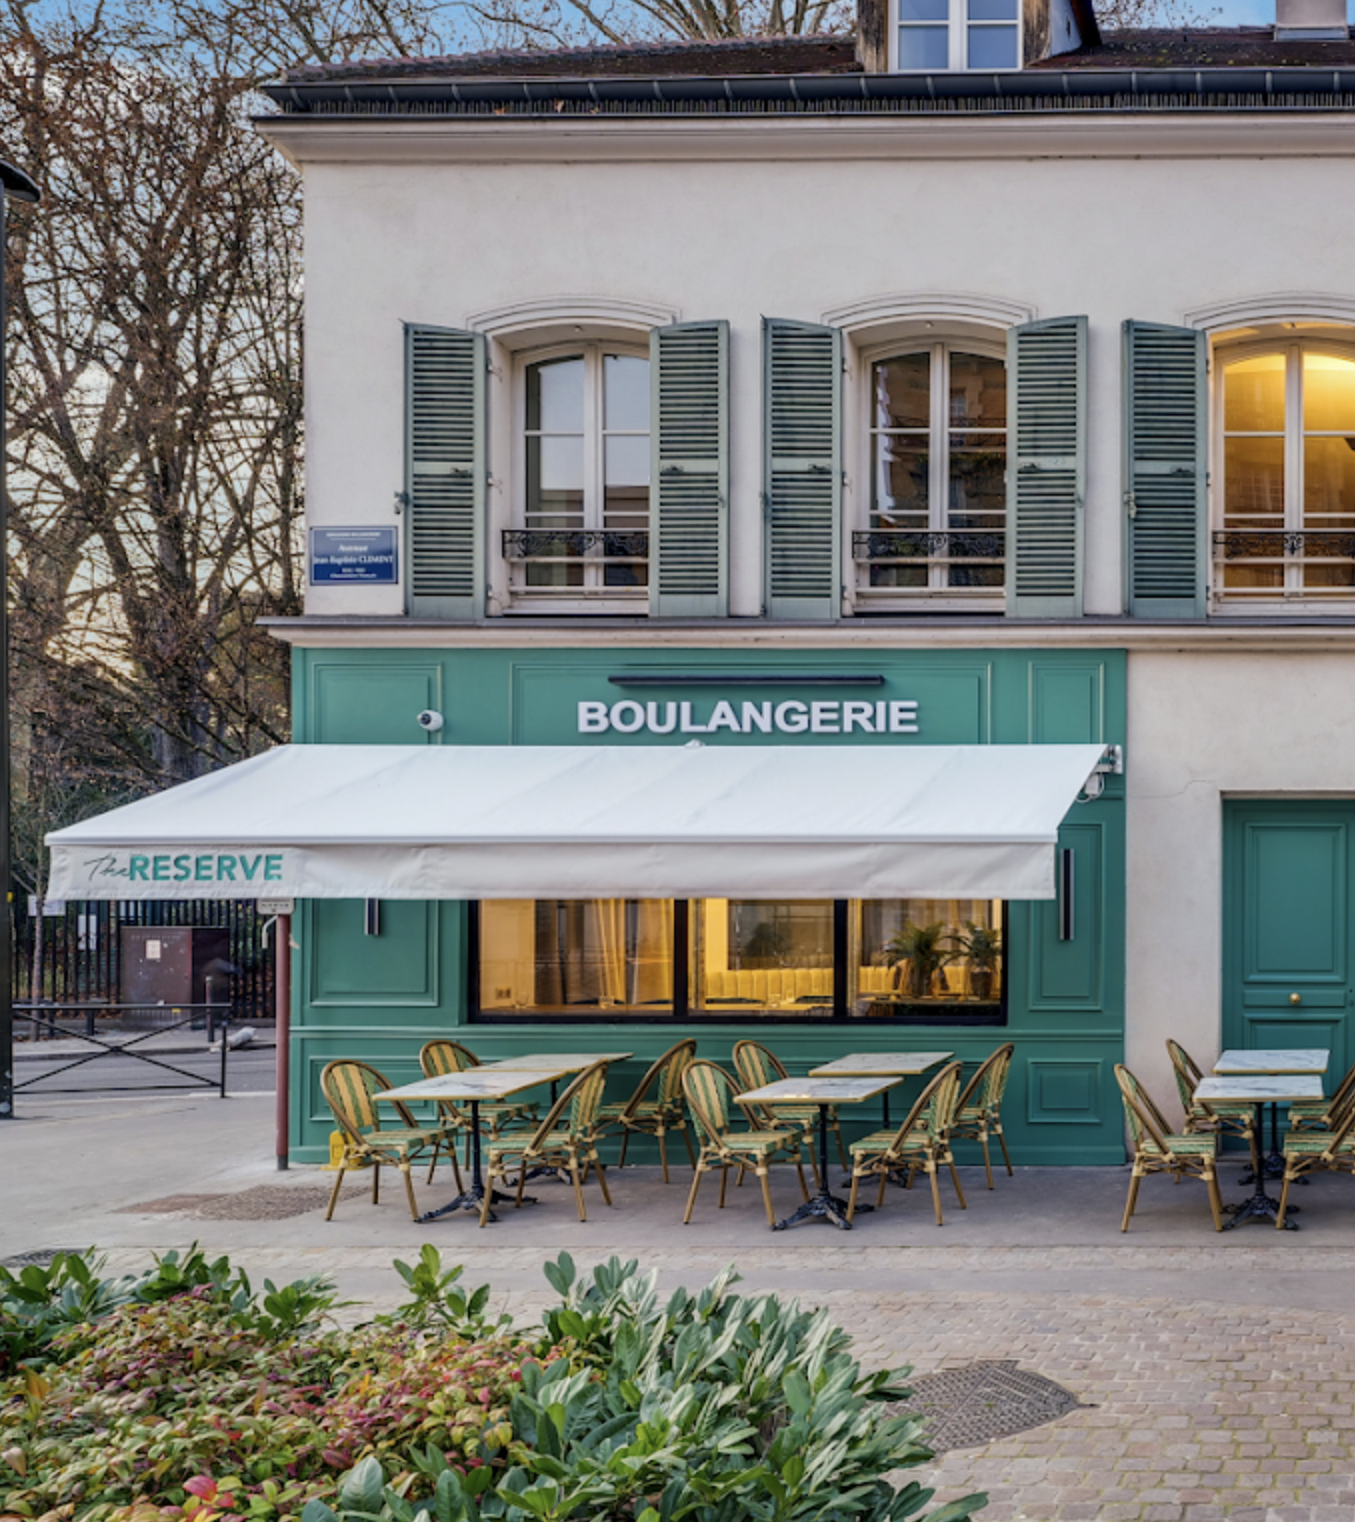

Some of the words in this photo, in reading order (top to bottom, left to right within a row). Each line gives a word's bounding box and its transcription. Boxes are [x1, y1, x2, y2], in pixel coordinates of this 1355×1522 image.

[338, 544, 369, 553] Avenue
[577, 700, 919, 733] BOULANGERIE
[129, 854, 283, 881] RESERVE
